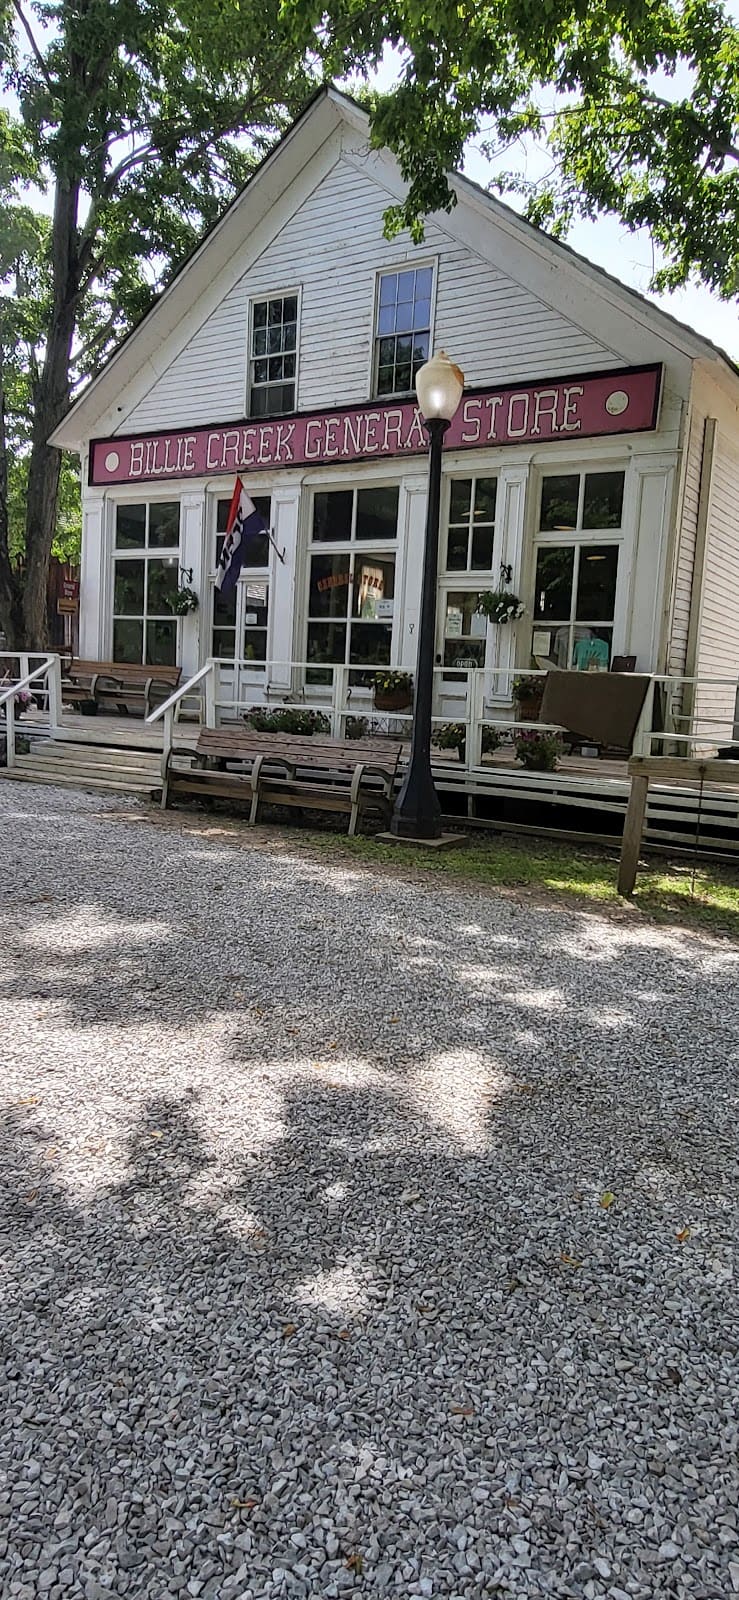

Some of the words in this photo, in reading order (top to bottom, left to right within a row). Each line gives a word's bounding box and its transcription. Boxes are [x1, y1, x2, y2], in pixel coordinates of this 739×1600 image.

[129, 436, 197, 476] BILLIE
[206, 423, 296, 469] CREEK
[304, 407, 445, 459] GENERA
[462, 387, 584, 443] STORE
